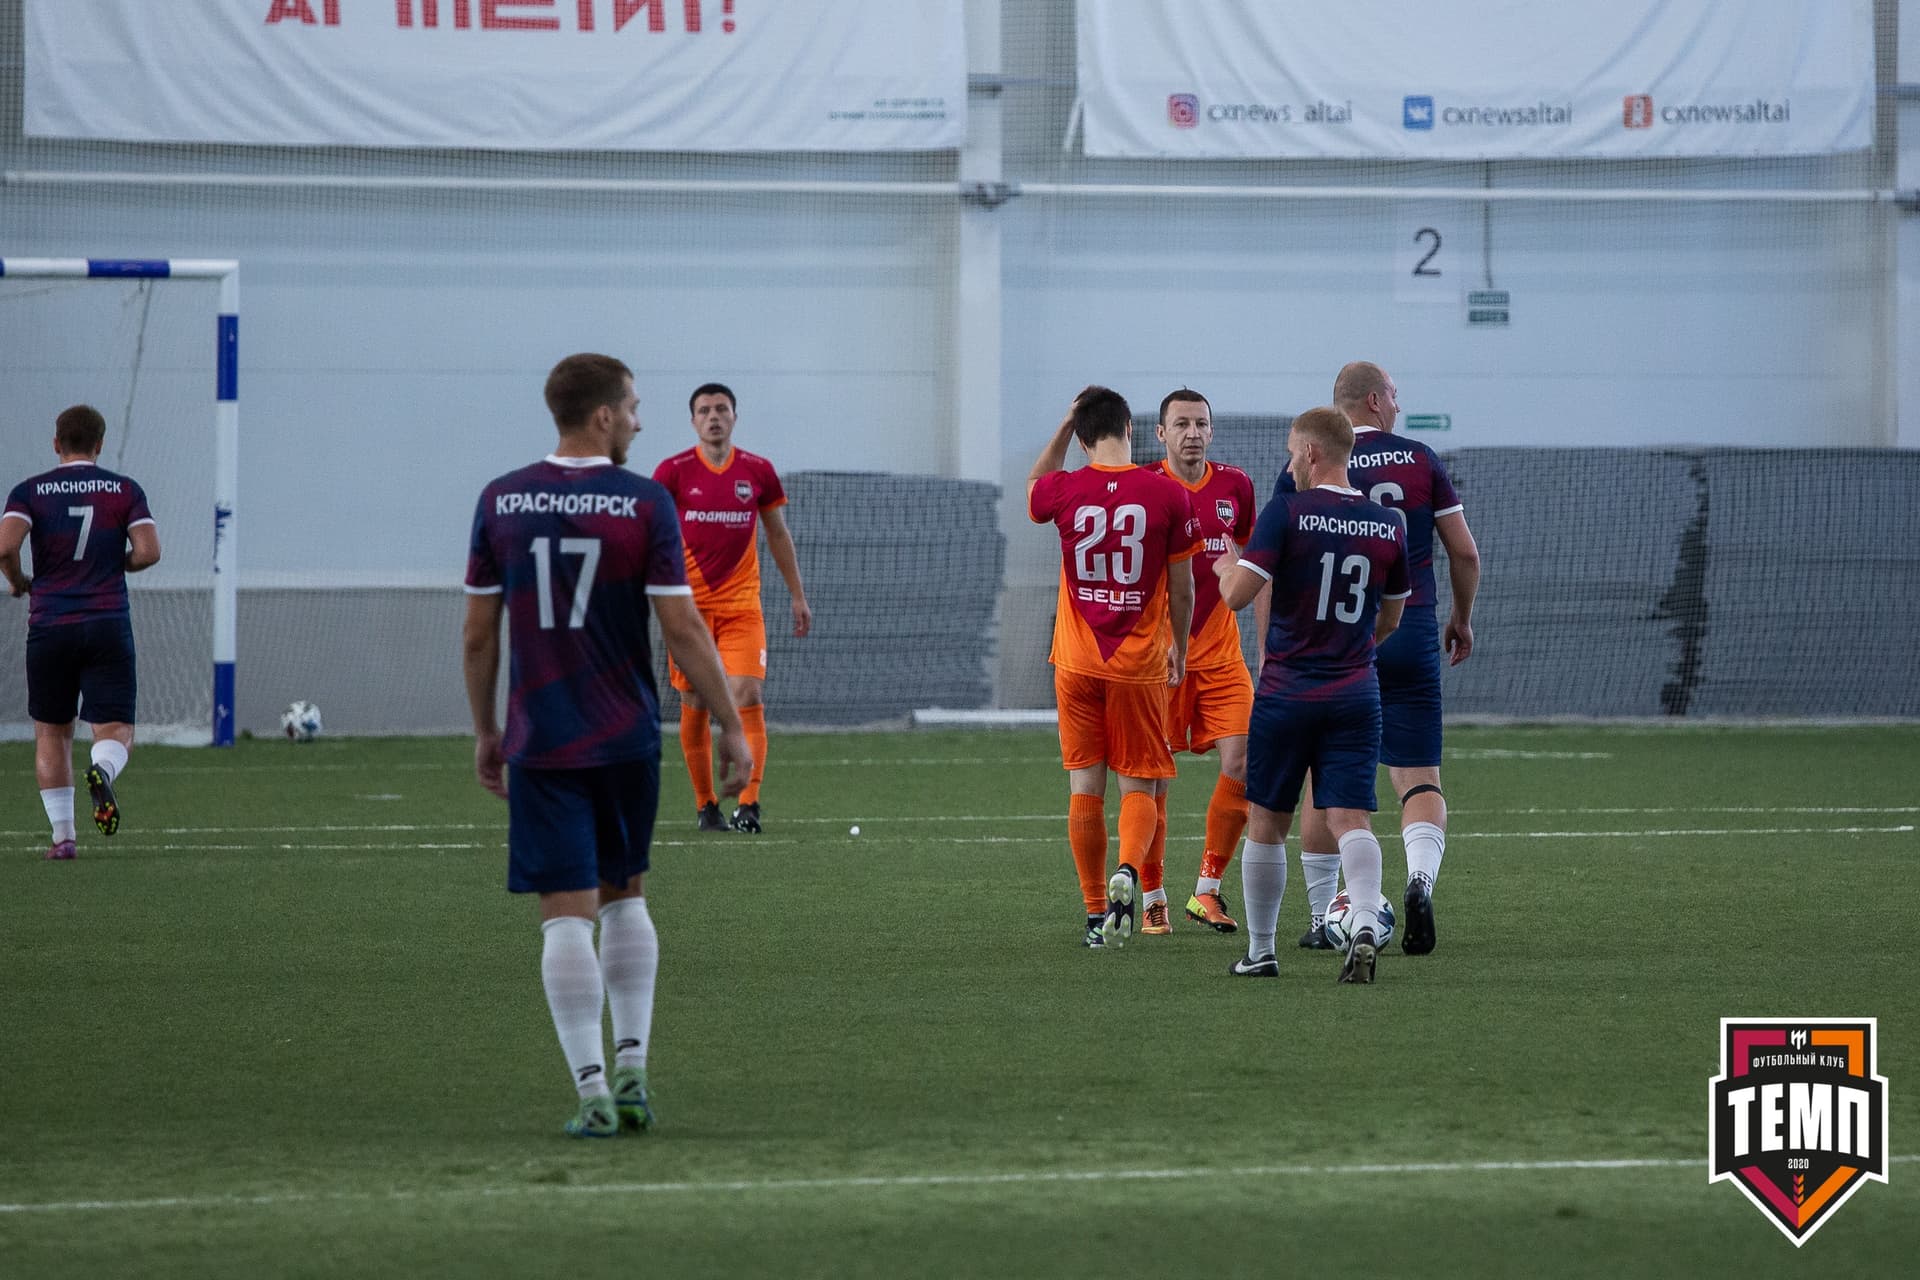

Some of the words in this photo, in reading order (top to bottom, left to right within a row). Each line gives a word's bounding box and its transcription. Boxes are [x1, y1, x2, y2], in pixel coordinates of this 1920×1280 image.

[1441, 101, 1573, 126] cxnewsaltai
[1660, 99, 1791, 124] cxnewsaltai
[1412, 227, 1443, 276] 2
[1348, 451, 1416, 469] НОЯРСК
[36, 479, 122, 495] КРАСНОЯРСК
[495, 491, 638, 519] КРАСНОЯРСК
[68, 505, 94, 561] 7
[1298, 514, 1396, 541] КРАСНОЯРСК
[1073, 504, 1147, 585] 23
[530, 537, 602, 630] 17
[1316, 552, 1371, 624] 13
